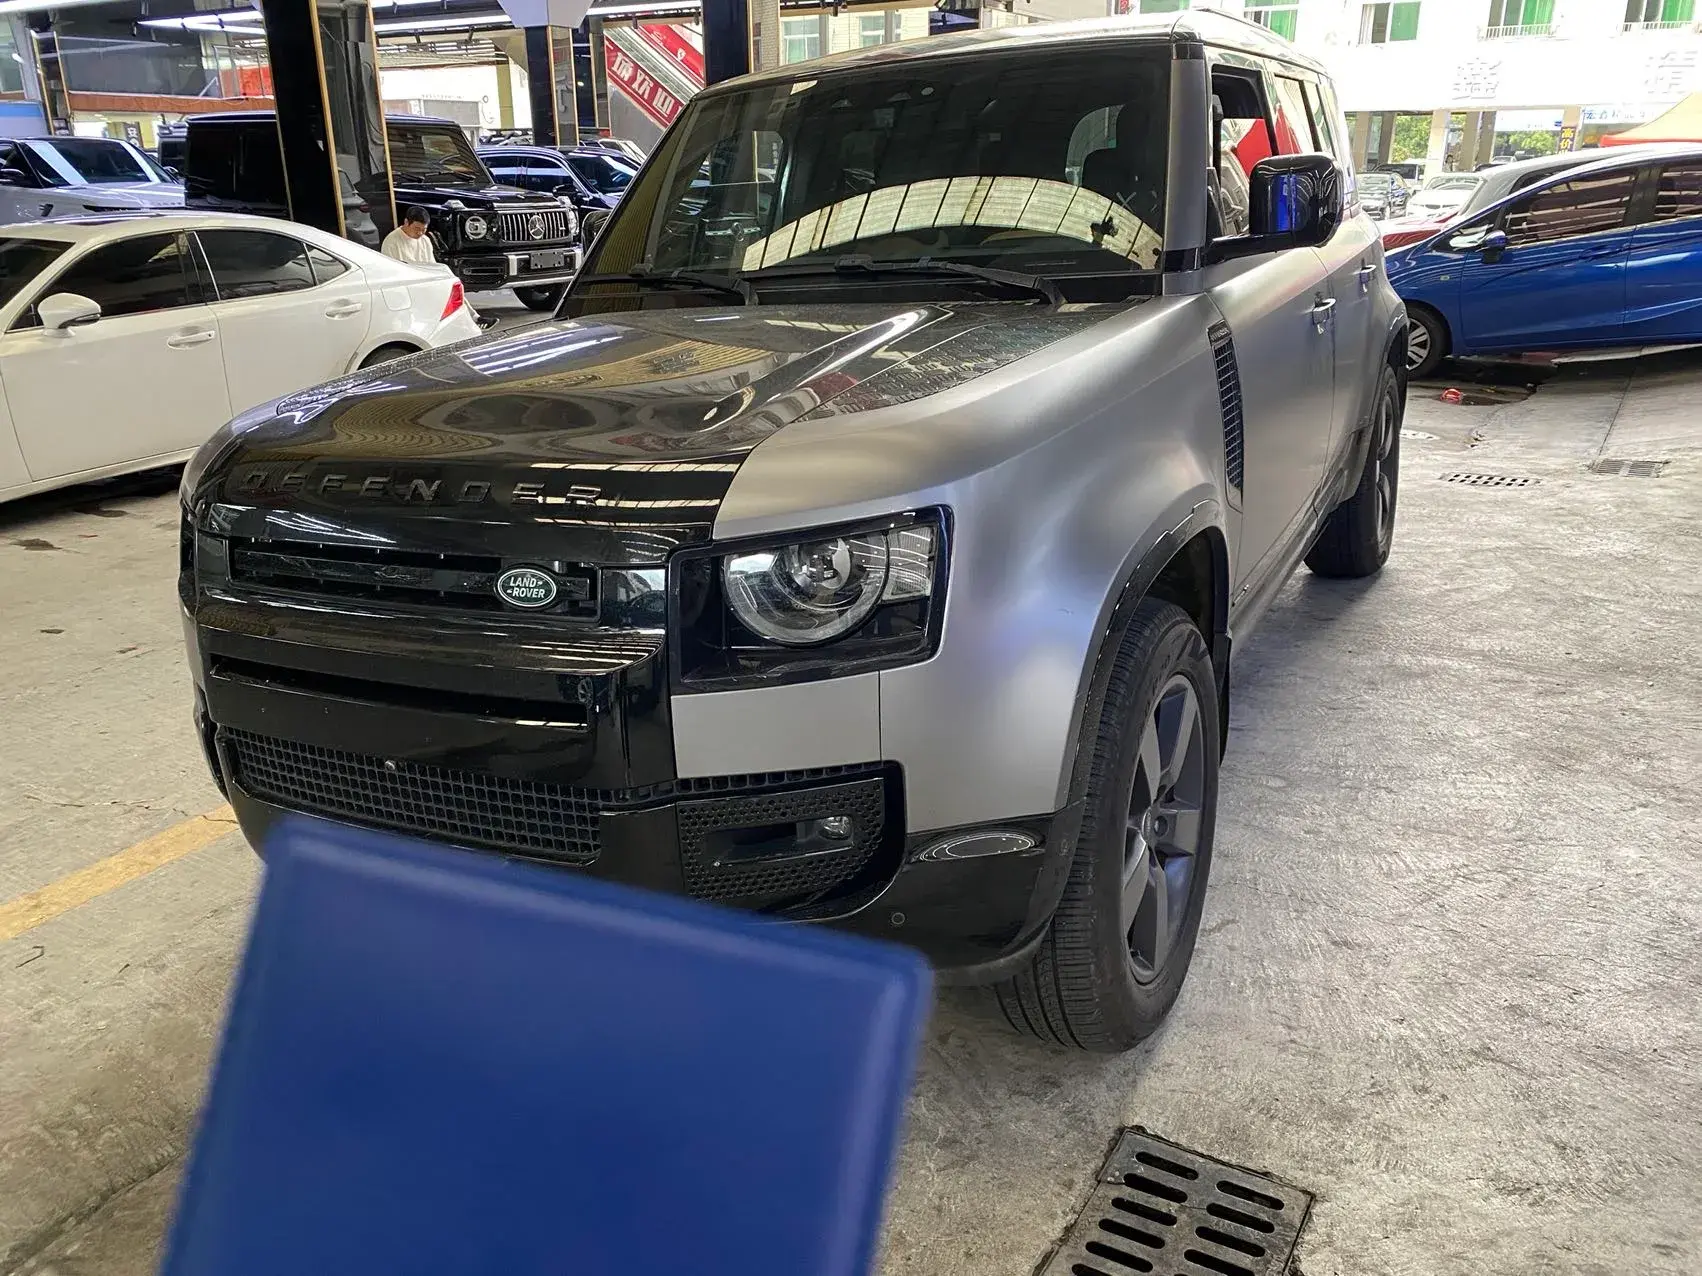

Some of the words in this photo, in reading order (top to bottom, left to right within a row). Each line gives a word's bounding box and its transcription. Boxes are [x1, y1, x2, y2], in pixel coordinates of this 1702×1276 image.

[1558, 128, 1575, 153] 高价
[241, 470, 602, 506] DEFENDER
[509, 576, 537, 588] LAND
[512, 587, 546, 599] ROVER
